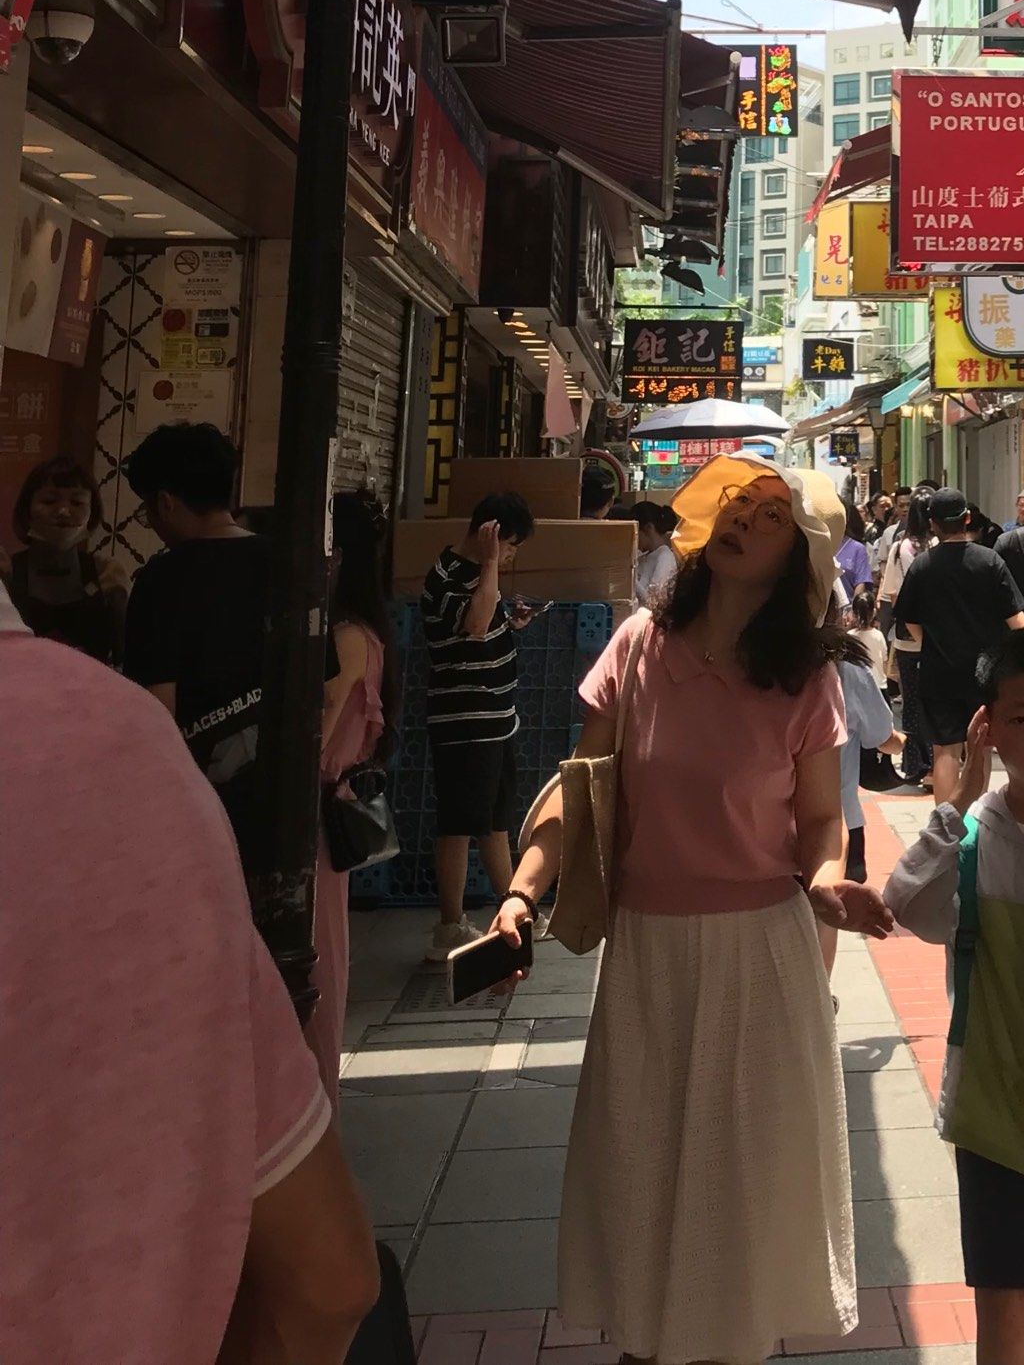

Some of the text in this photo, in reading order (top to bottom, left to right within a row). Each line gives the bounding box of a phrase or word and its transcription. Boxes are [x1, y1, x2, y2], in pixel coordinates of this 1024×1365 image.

[912, 214, 974, 229] TAIPA
[632, 327, 716, 365] 鉅記
[722, 325, 736, 353] 手信
[661, 365, 690, 374] BAKERY
